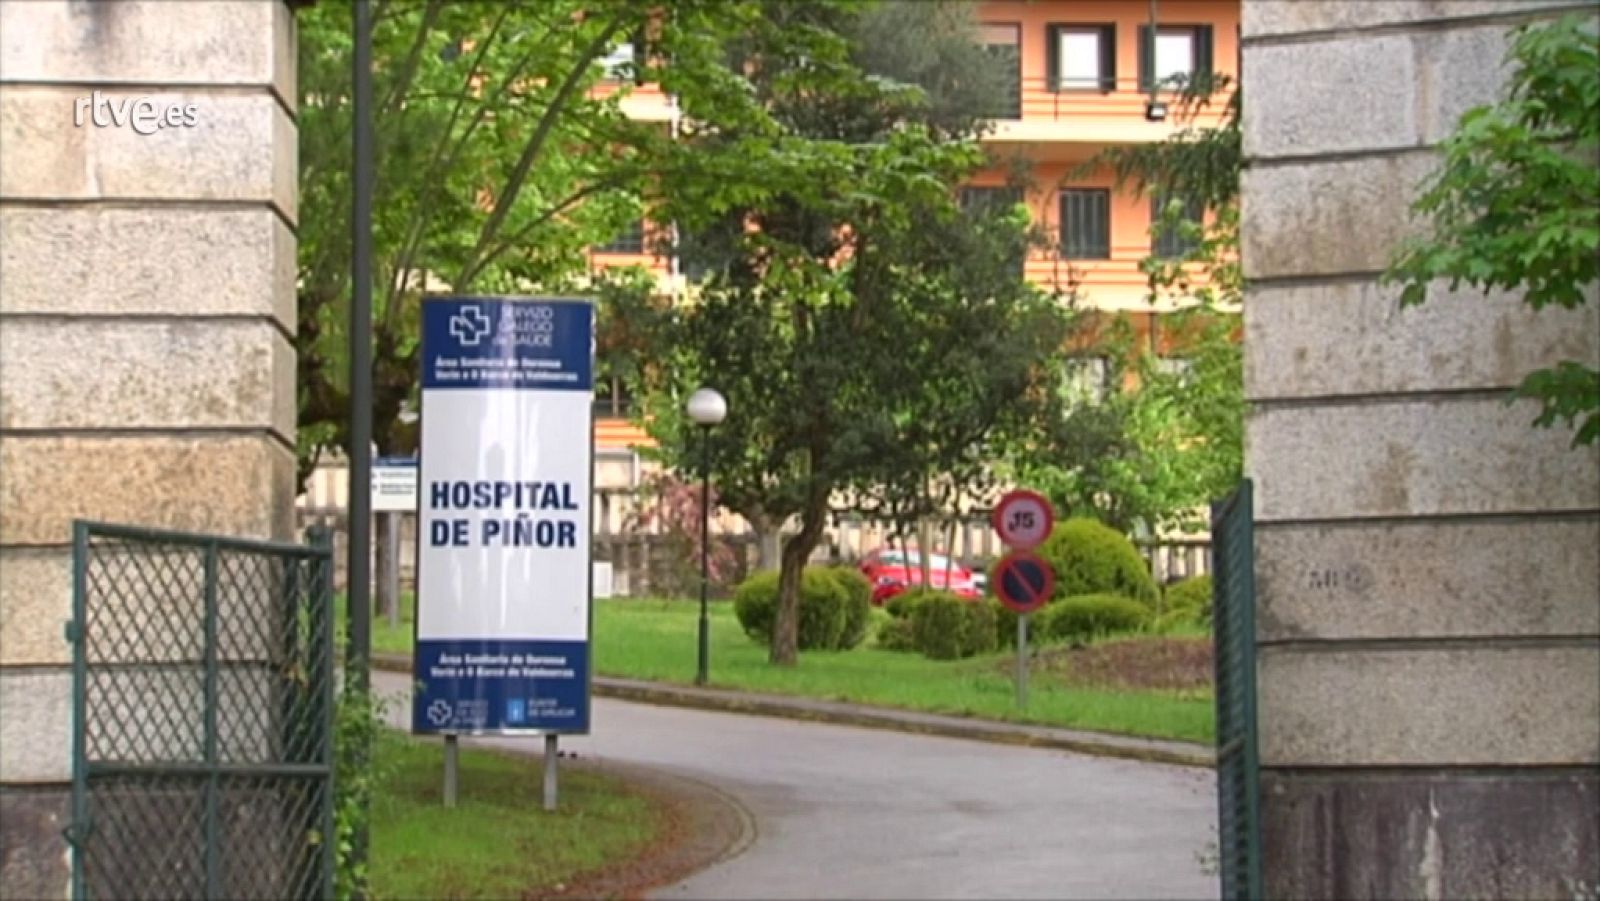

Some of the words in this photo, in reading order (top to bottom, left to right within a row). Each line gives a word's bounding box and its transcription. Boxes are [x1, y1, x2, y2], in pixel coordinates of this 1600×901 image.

[431, 481, 579, 510] HOSPITAL
[431, 519, 469, 547] DE
[482, 512, 576, 548] PIÑOR
